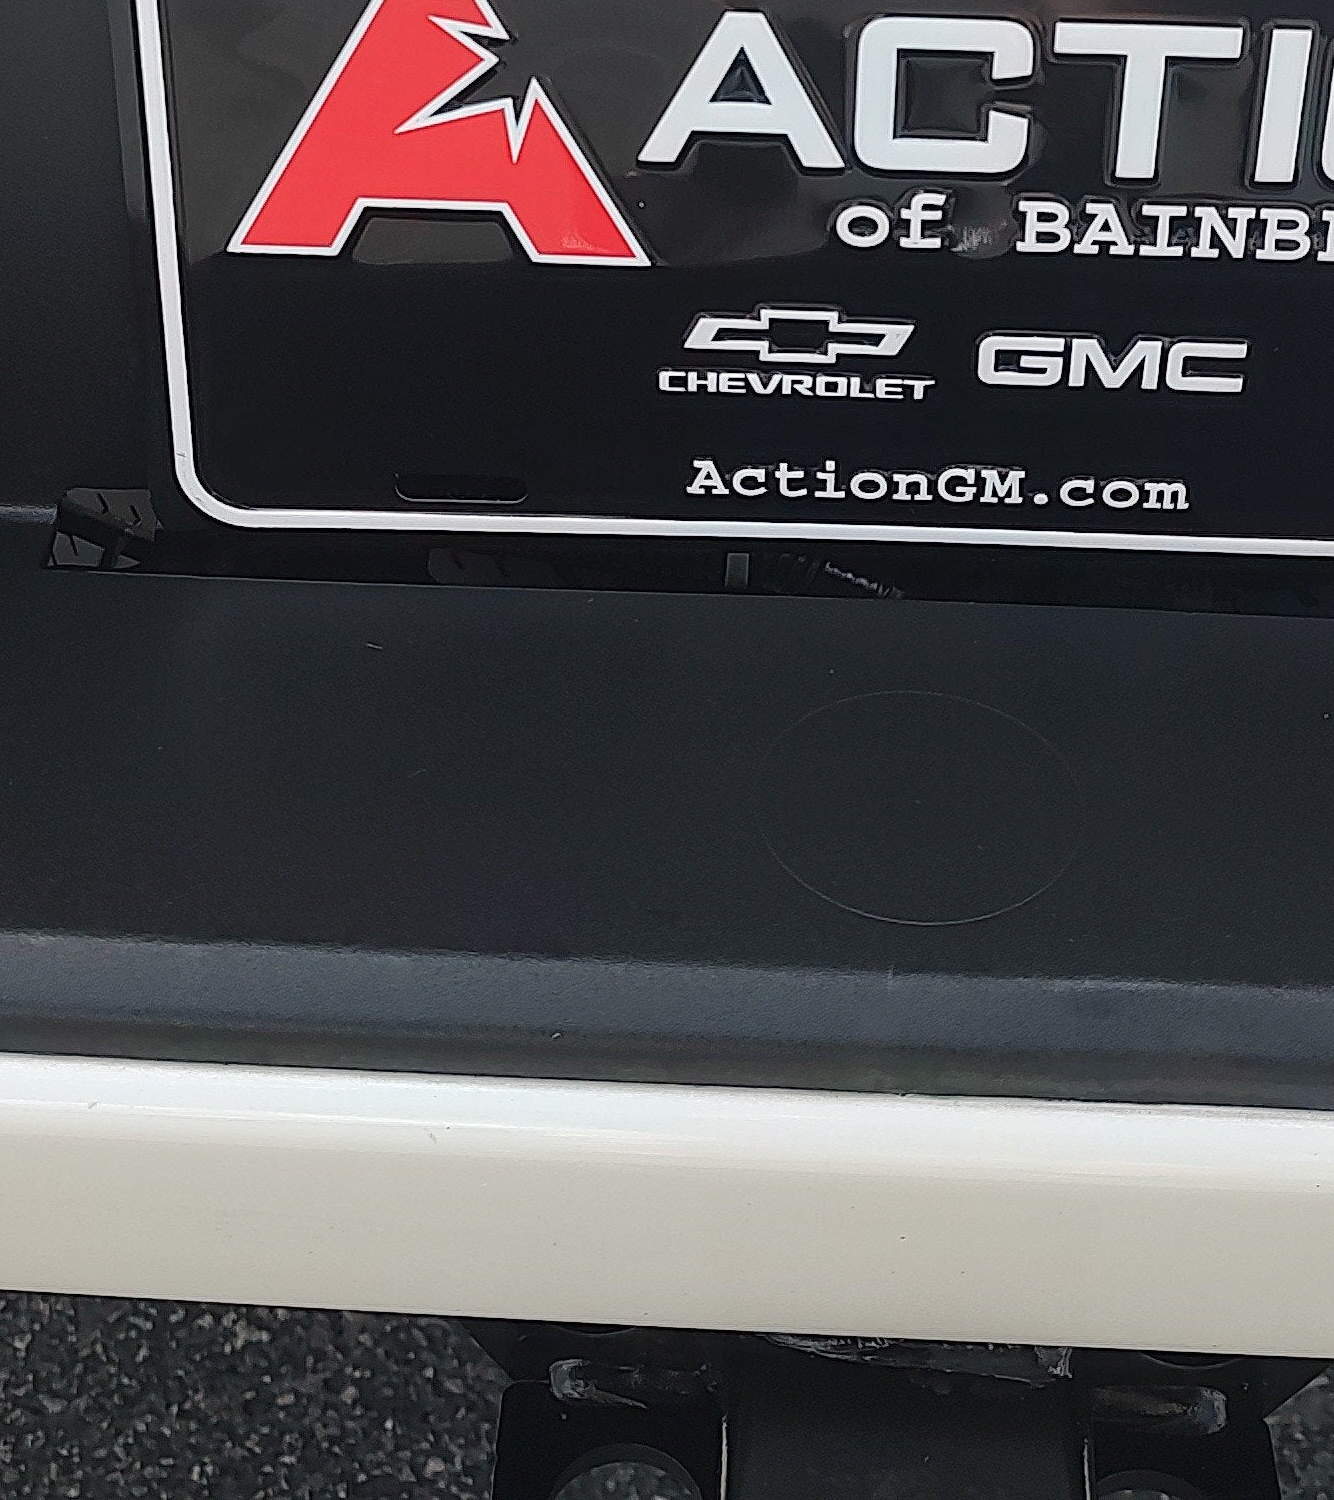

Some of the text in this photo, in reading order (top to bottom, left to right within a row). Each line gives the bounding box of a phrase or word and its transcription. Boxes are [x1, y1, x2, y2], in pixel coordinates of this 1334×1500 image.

[835, 192, 947, 249] of
[658, 370, 936, 400] CHEVROLET
[978, 336, 1248, 393] GMC
[686, 460, 1190, 510] ActionGM.com
